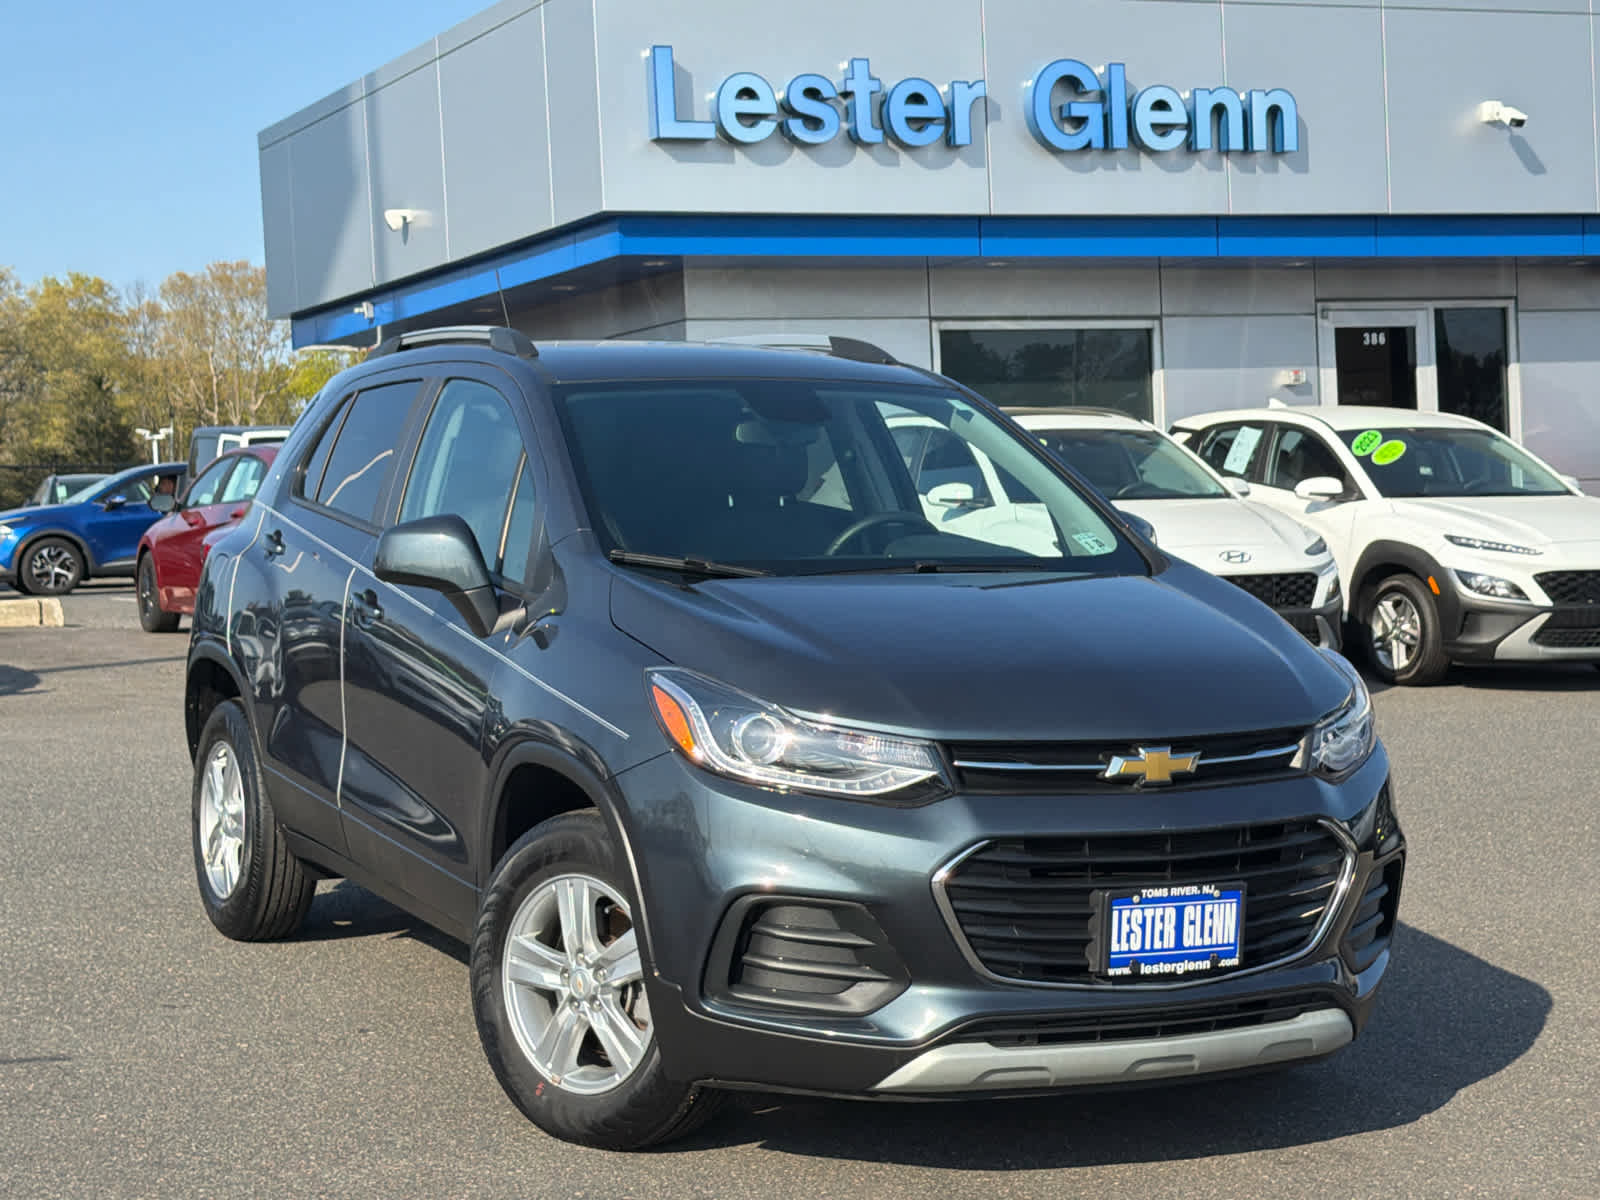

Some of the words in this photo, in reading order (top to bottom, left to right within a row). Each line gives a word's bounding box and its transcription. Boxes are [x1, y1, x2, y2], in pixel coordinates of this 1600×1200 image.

[648, 44, 986, 147] Lester
[1025, 58, 1300, 153] Glenn
[1141, 888, 1169, 899] TOMS
[1202, 884, 1215, 894] NJ
[1111, 906, 1176, 952] LESTER
[1182, 902, 1237, 948] GLENN
